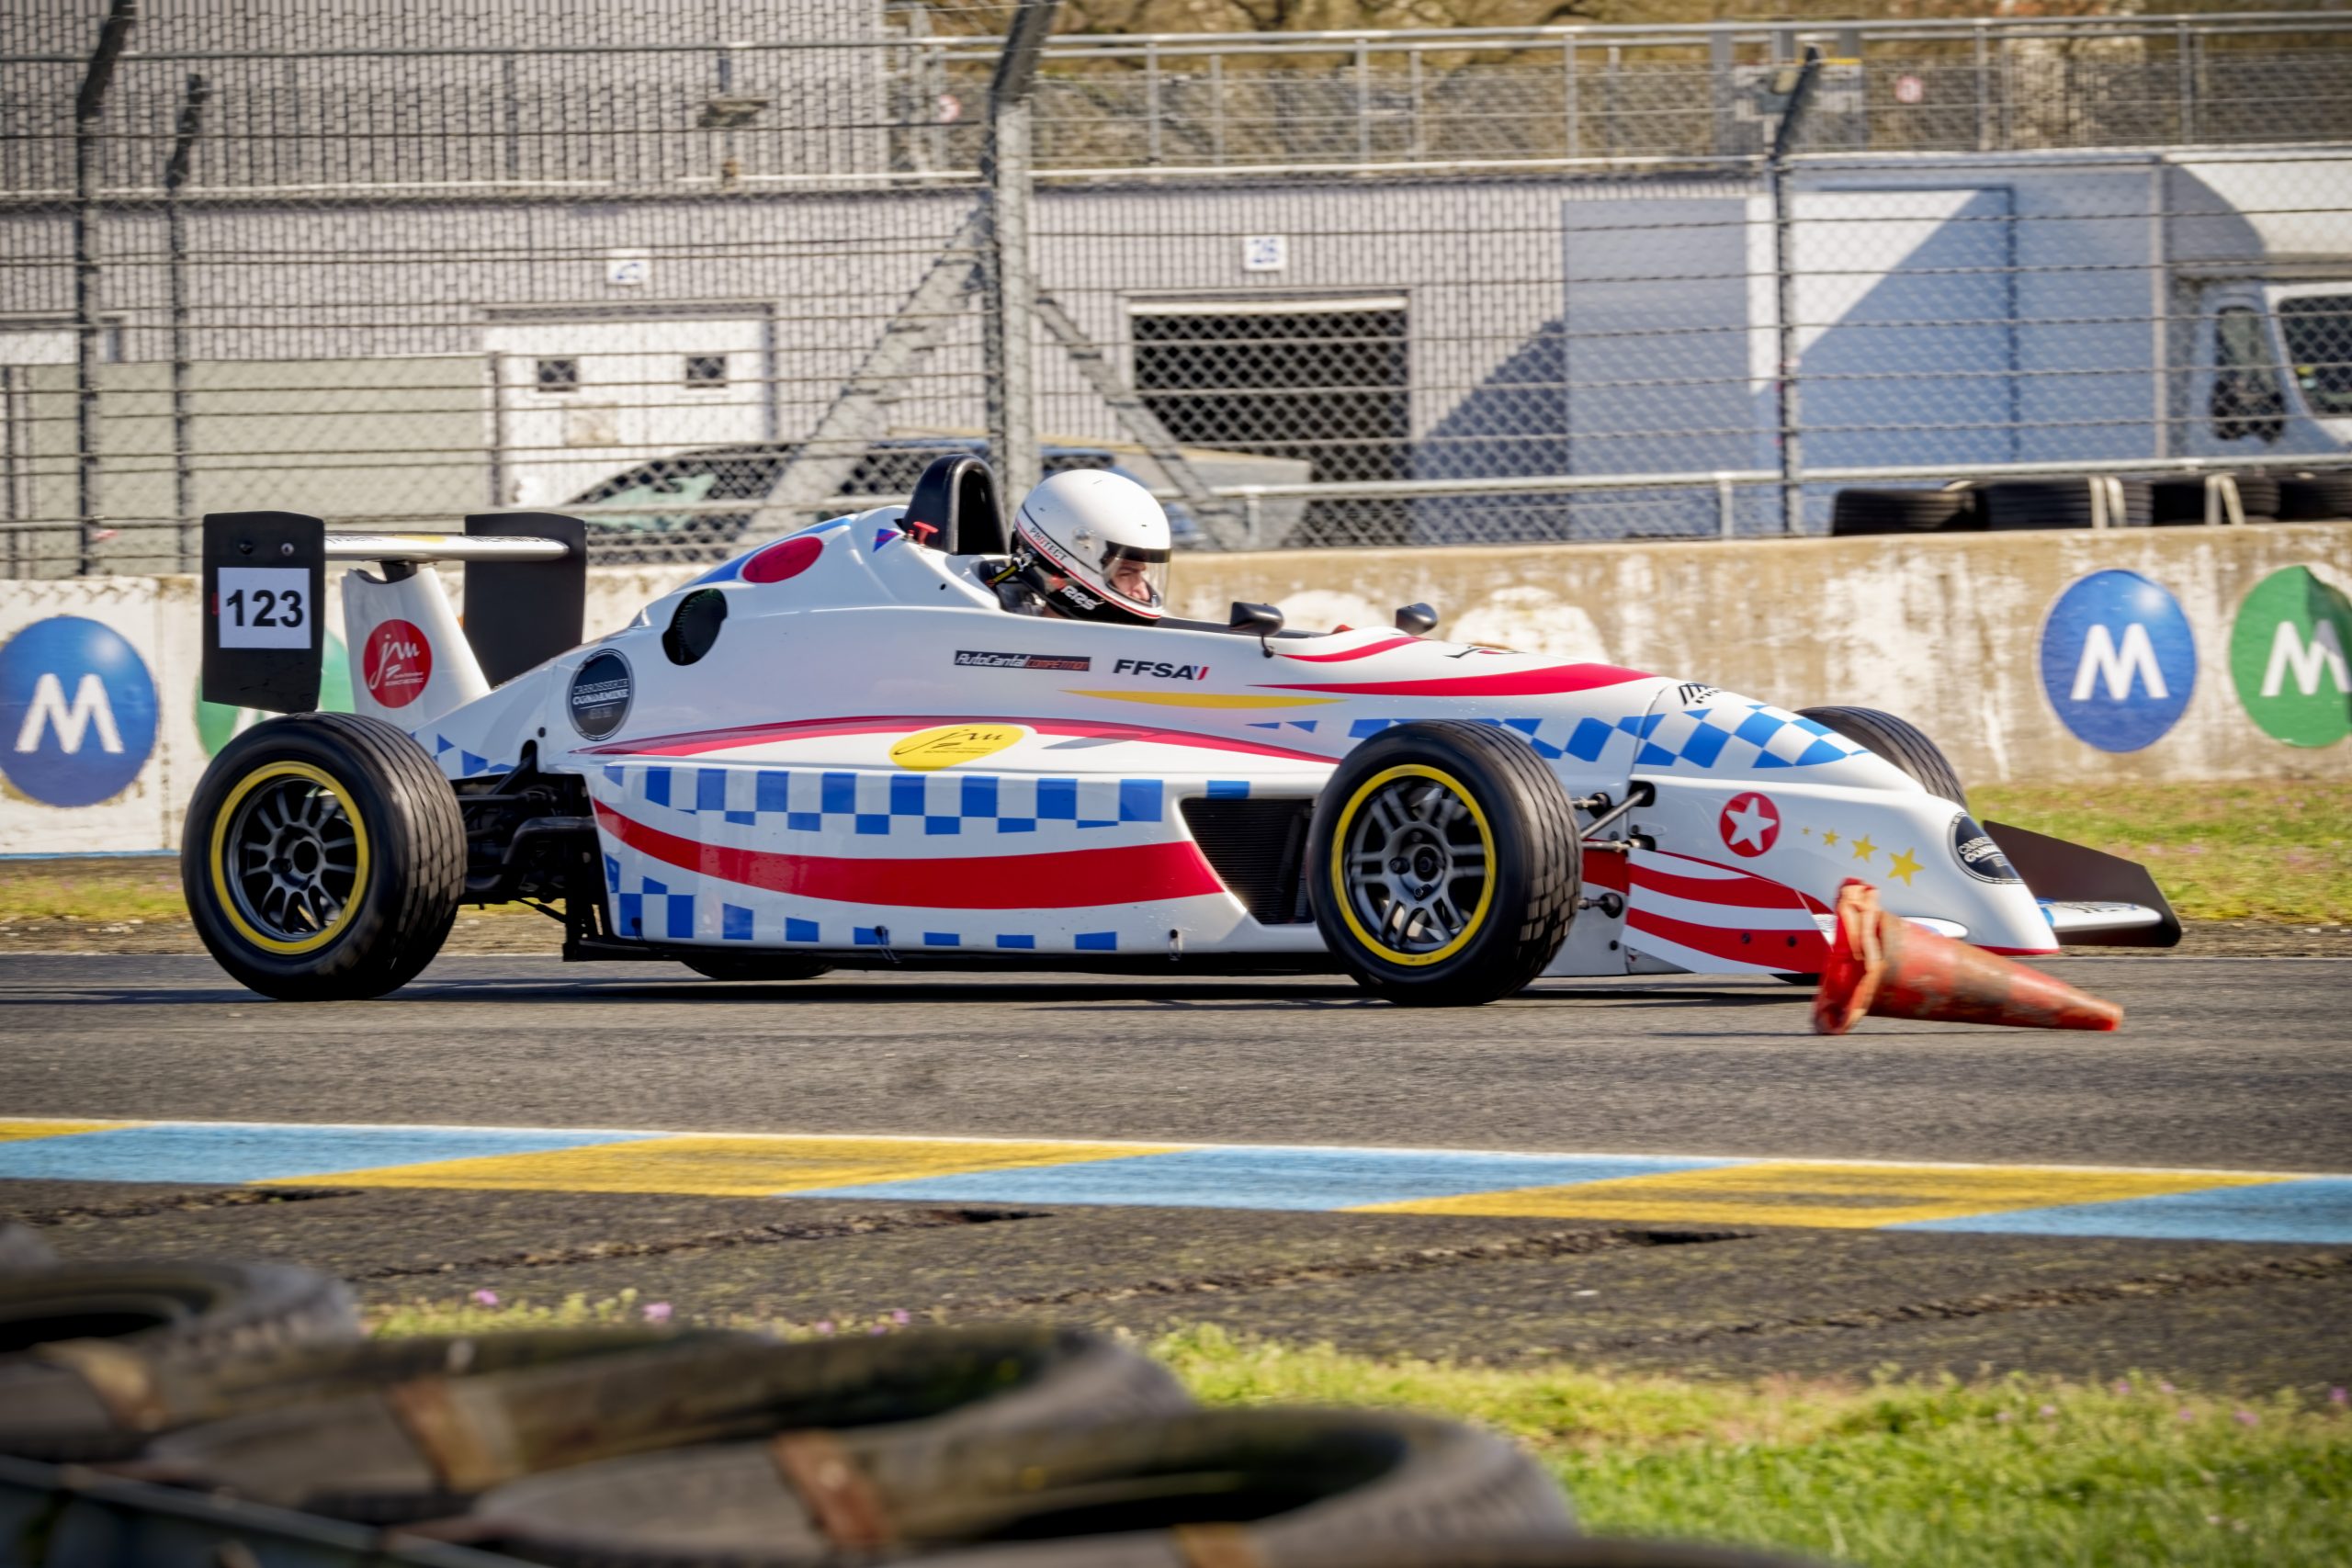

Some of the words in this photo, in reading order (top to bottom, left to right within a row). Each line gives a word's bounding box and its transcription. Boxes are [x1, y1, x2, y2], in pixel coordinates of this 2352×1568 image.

[225, 589, 305, 628] 123
[1060, 585, 1098, 610] RRS
[956, 653, 1031, 668] AutoCantal
[1113, 659, 1193, 681] FFSA
[2070, 623, 2169, 700] M
[2259, 619, 2352, 697] M
[14, 672, 125, 754] M
